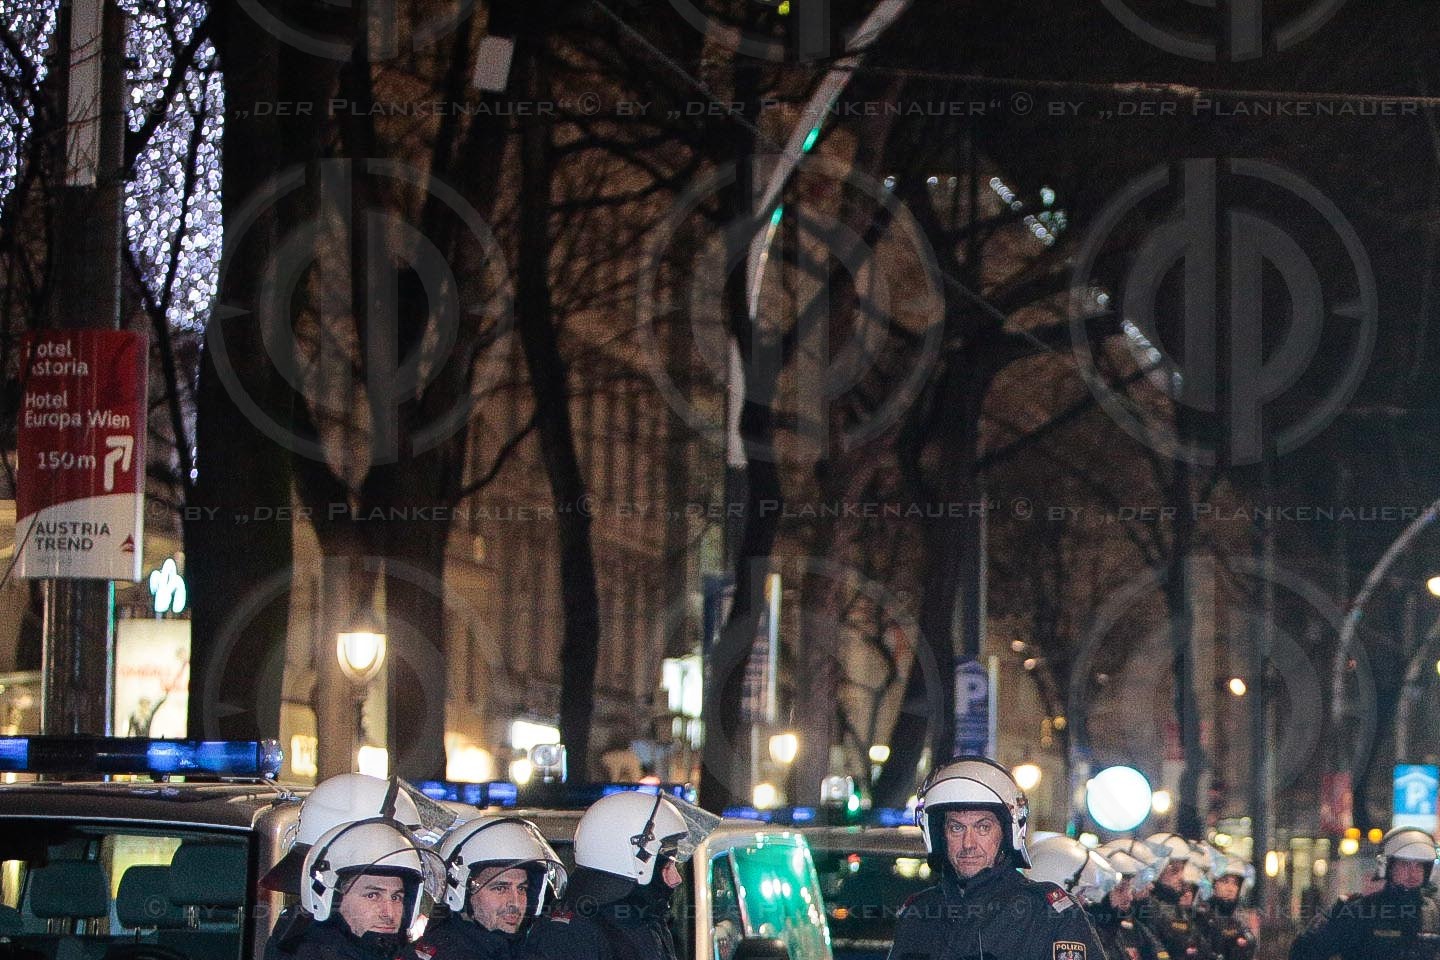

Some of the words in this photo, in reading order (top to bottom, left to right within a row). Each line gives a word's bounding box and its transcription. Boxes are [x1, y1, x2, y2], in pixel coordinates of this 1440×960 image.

[25, 391, 68, 408] Hotel
[25, 411, 82, 430] Europa
[87, 410, 130, 428] Wien
[34, 521, 111, 536] AUSTRIA
[34, 536, 94, 551] TREND
